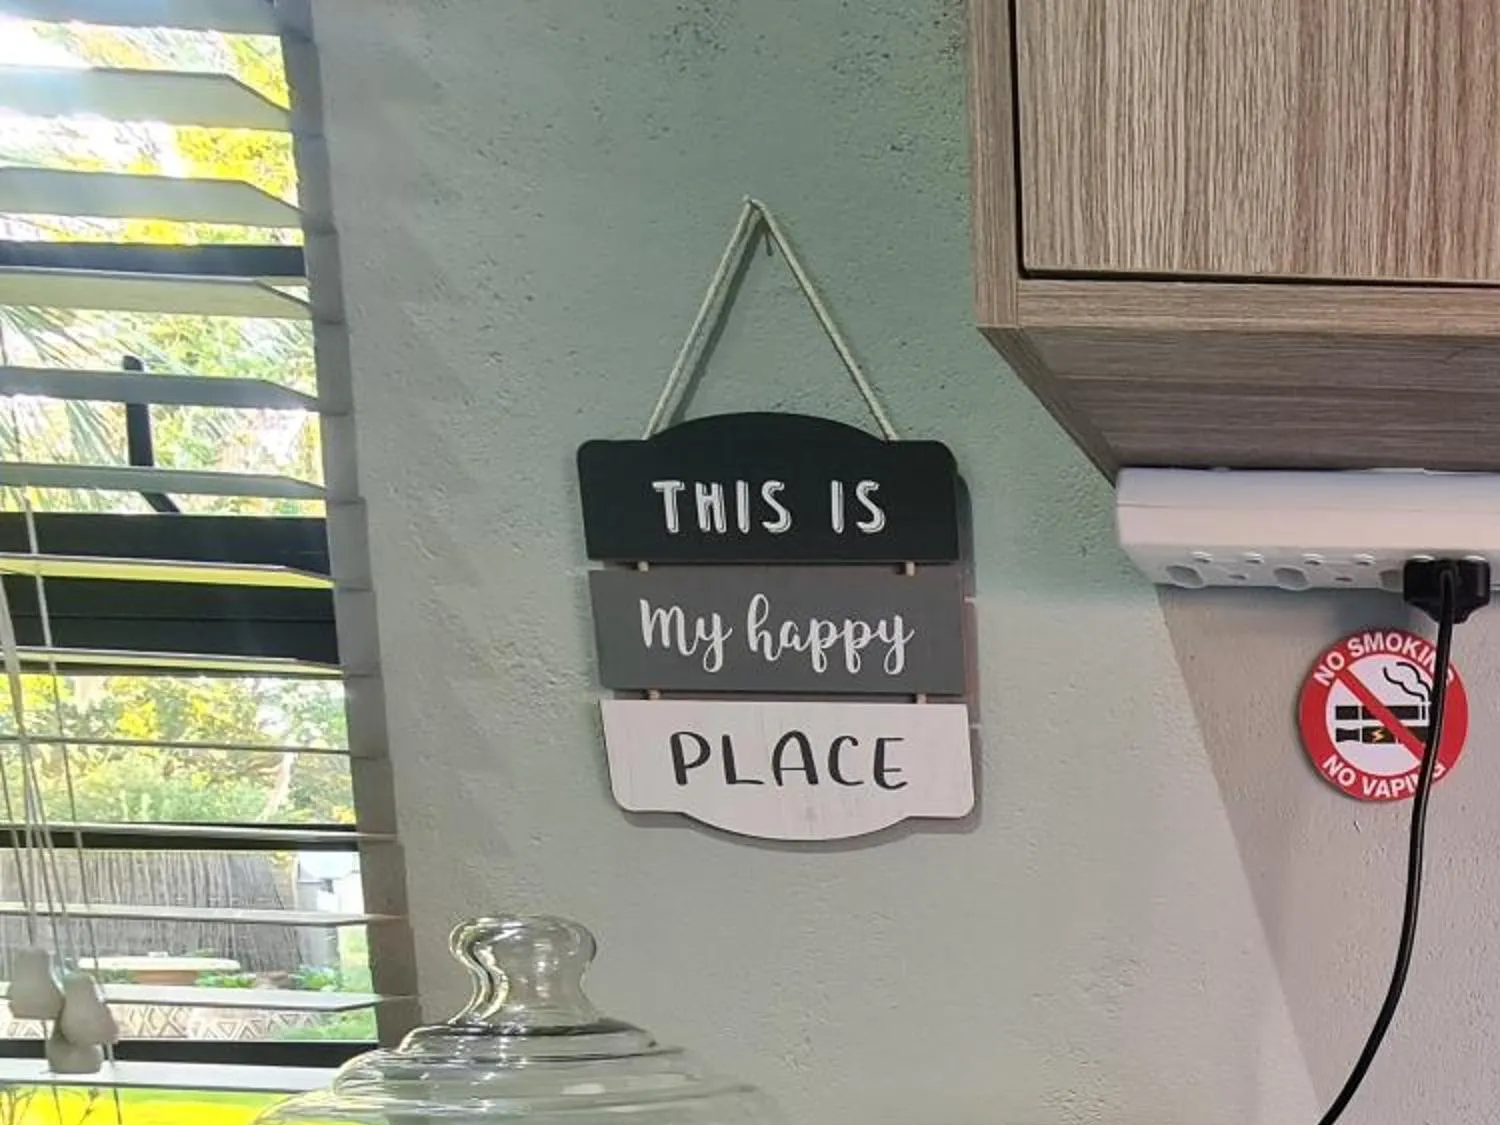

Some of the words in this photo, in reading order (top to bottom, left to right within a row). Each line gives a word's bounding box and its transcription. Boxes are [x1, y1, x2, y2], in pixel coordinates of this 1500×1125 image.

[651, 479, 793, 534] THIS
[830, 479, 887, 534] IS
[746, 593, 916, 675] happy
[1312, 651, 1345, 687] NO
[669, 730, 909, 791] PLACE
[1321, 754, 1356, 787] NO
